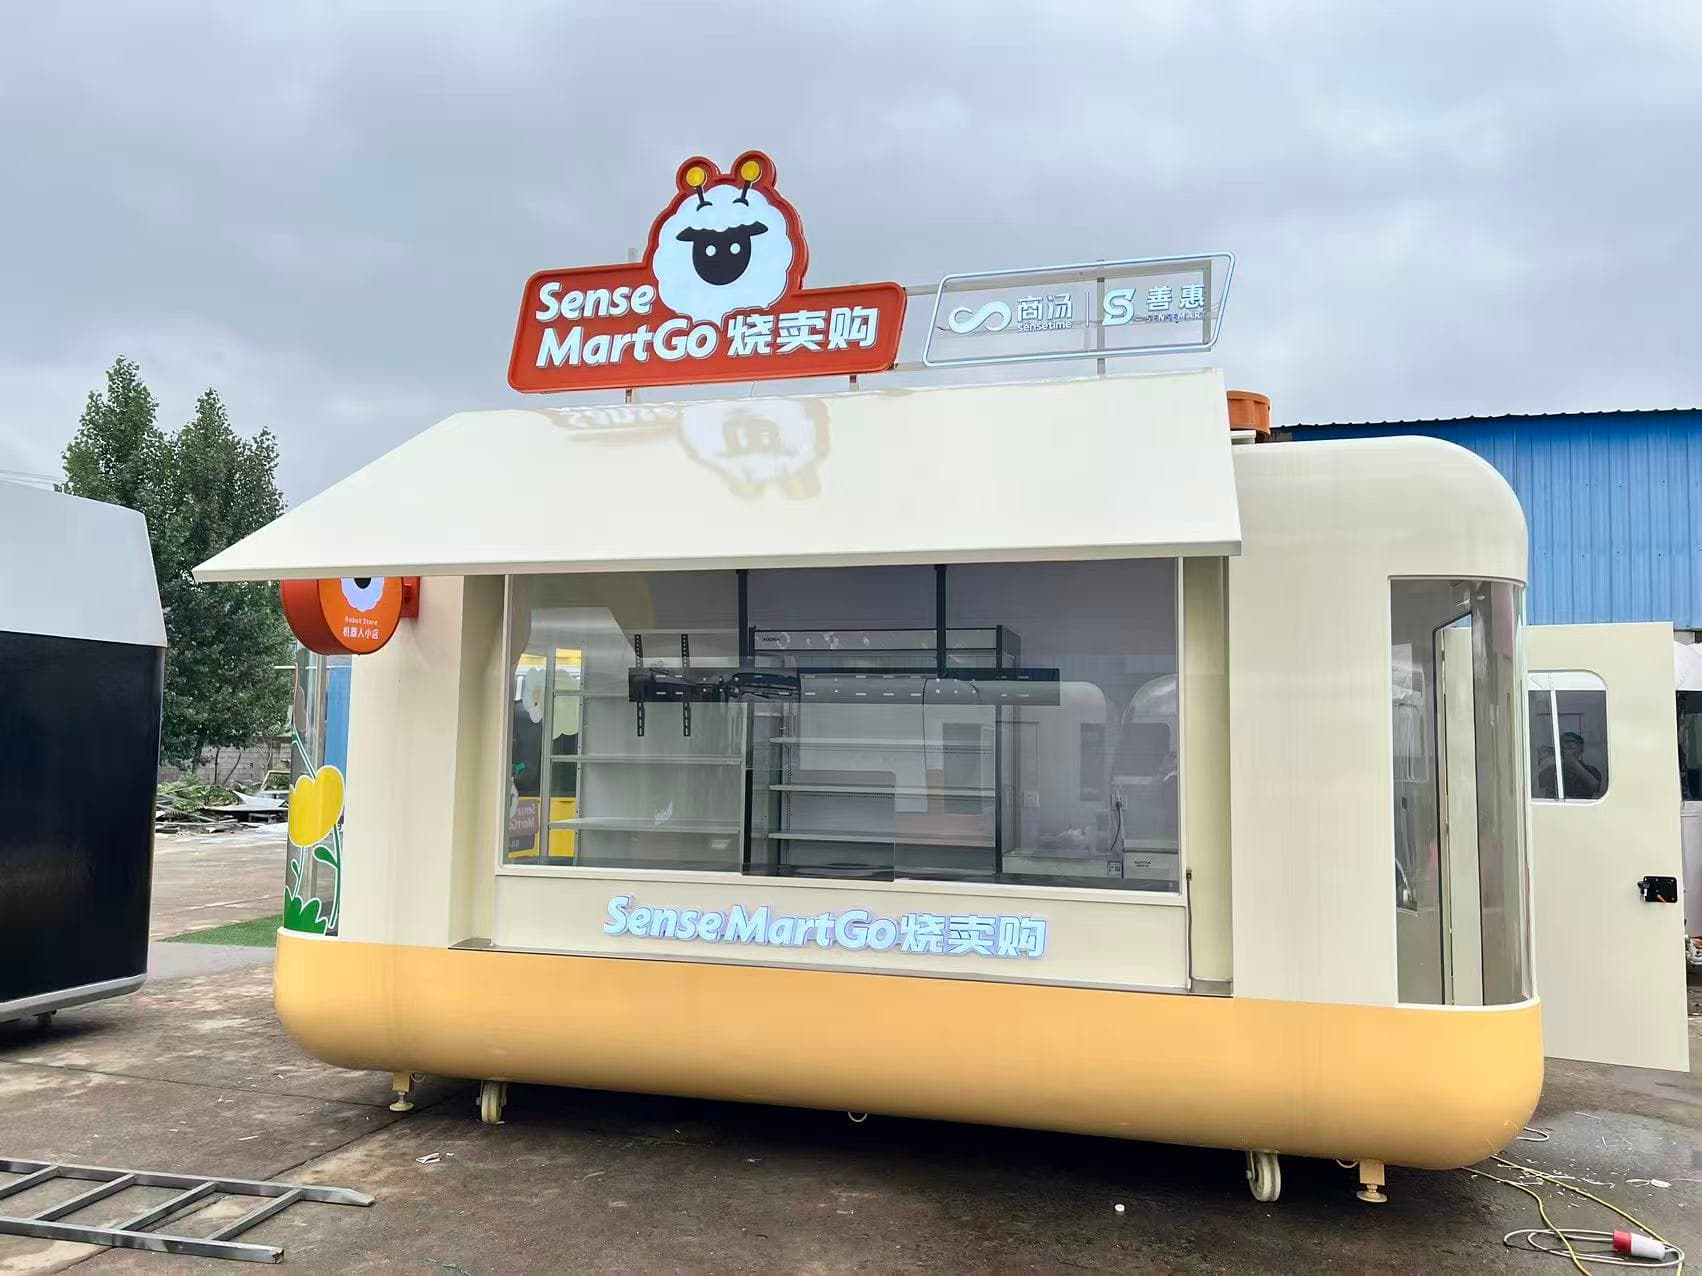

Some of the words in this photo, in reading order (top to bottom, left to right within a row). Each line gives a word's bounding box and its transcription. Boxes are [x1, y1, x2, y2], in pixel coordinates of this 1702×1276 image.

[535, 281, 655, 321] Sense
[1017, 294, 1073, 321] 商汤
[1146, 283, 1206, 311] 善惠
[536, 319, 718, 367] MartGo
[727, 306, 879, 356] 烧卖购
[343, 626, 380, 640] 机器人小店
